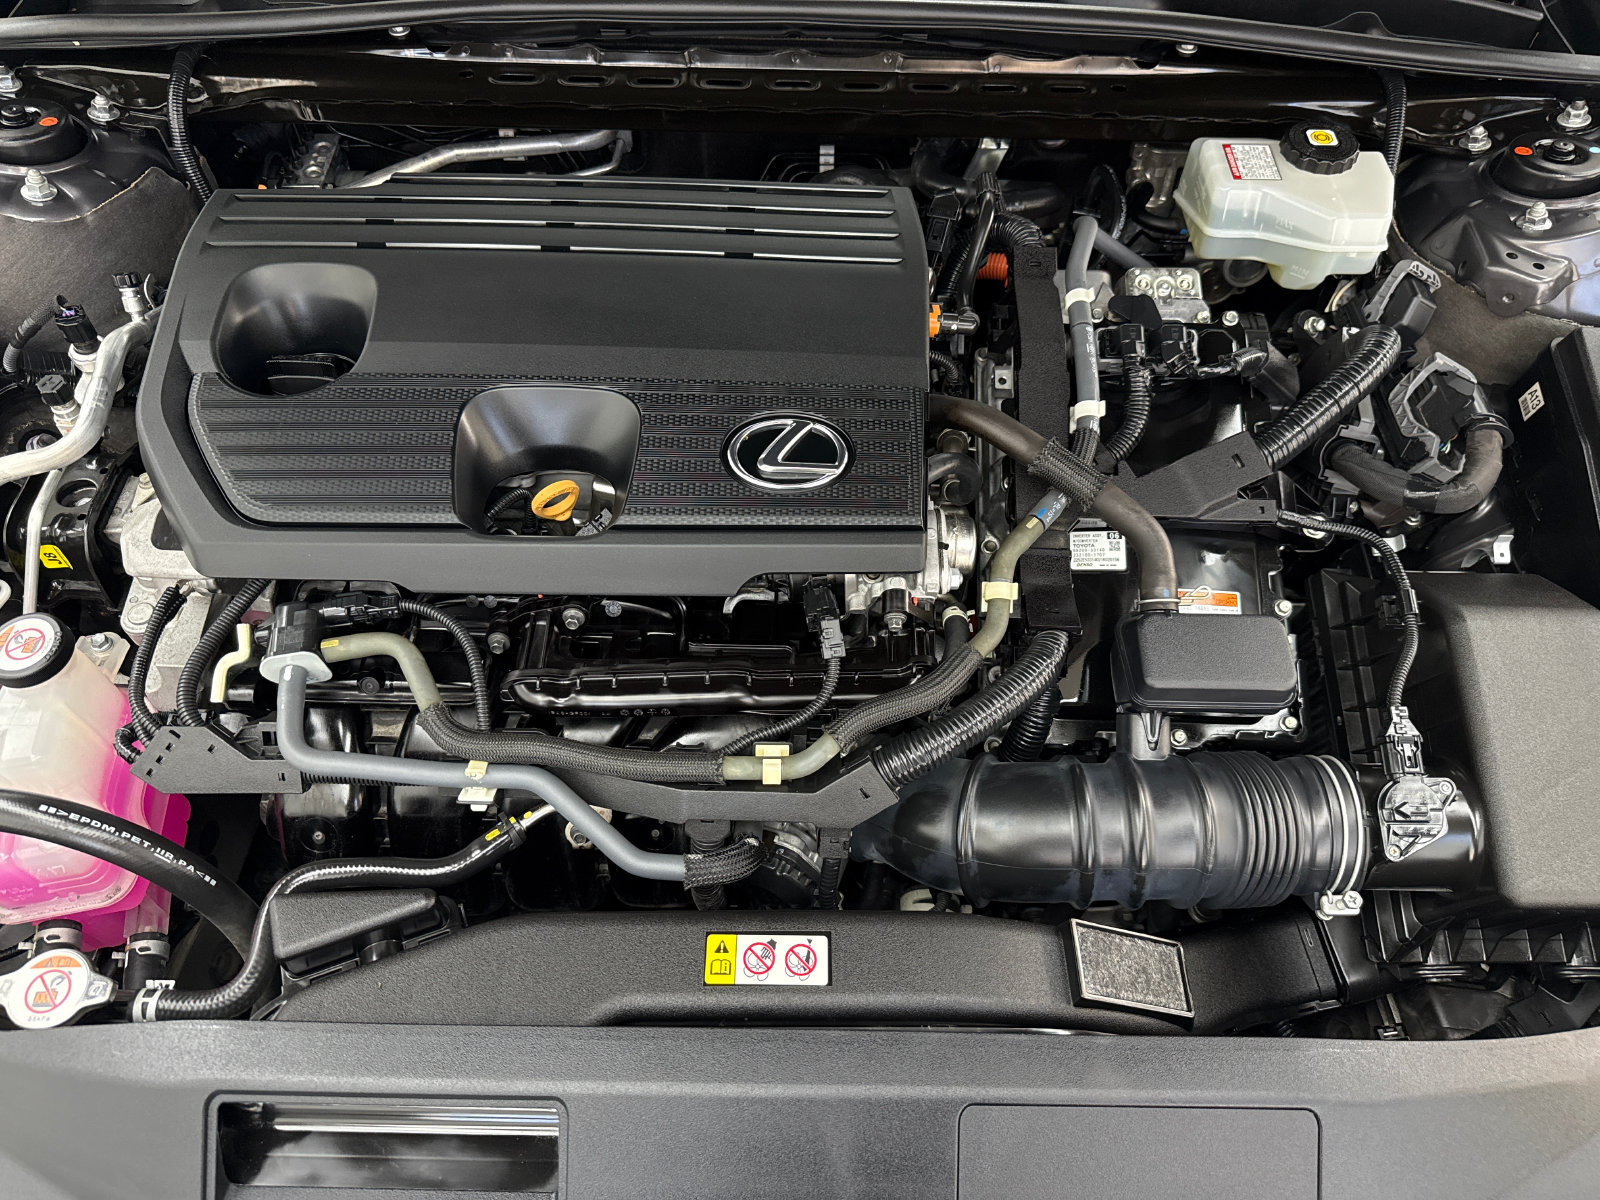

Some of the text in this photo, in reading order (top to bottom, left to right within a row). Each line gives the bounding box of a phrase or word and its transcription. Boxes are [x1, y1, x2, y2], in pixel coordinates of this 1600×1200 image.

[1528, 389, 1541, 410] A13
[43, 552, 63, 565] J8
[44, 630, 62, 661] DENSO
